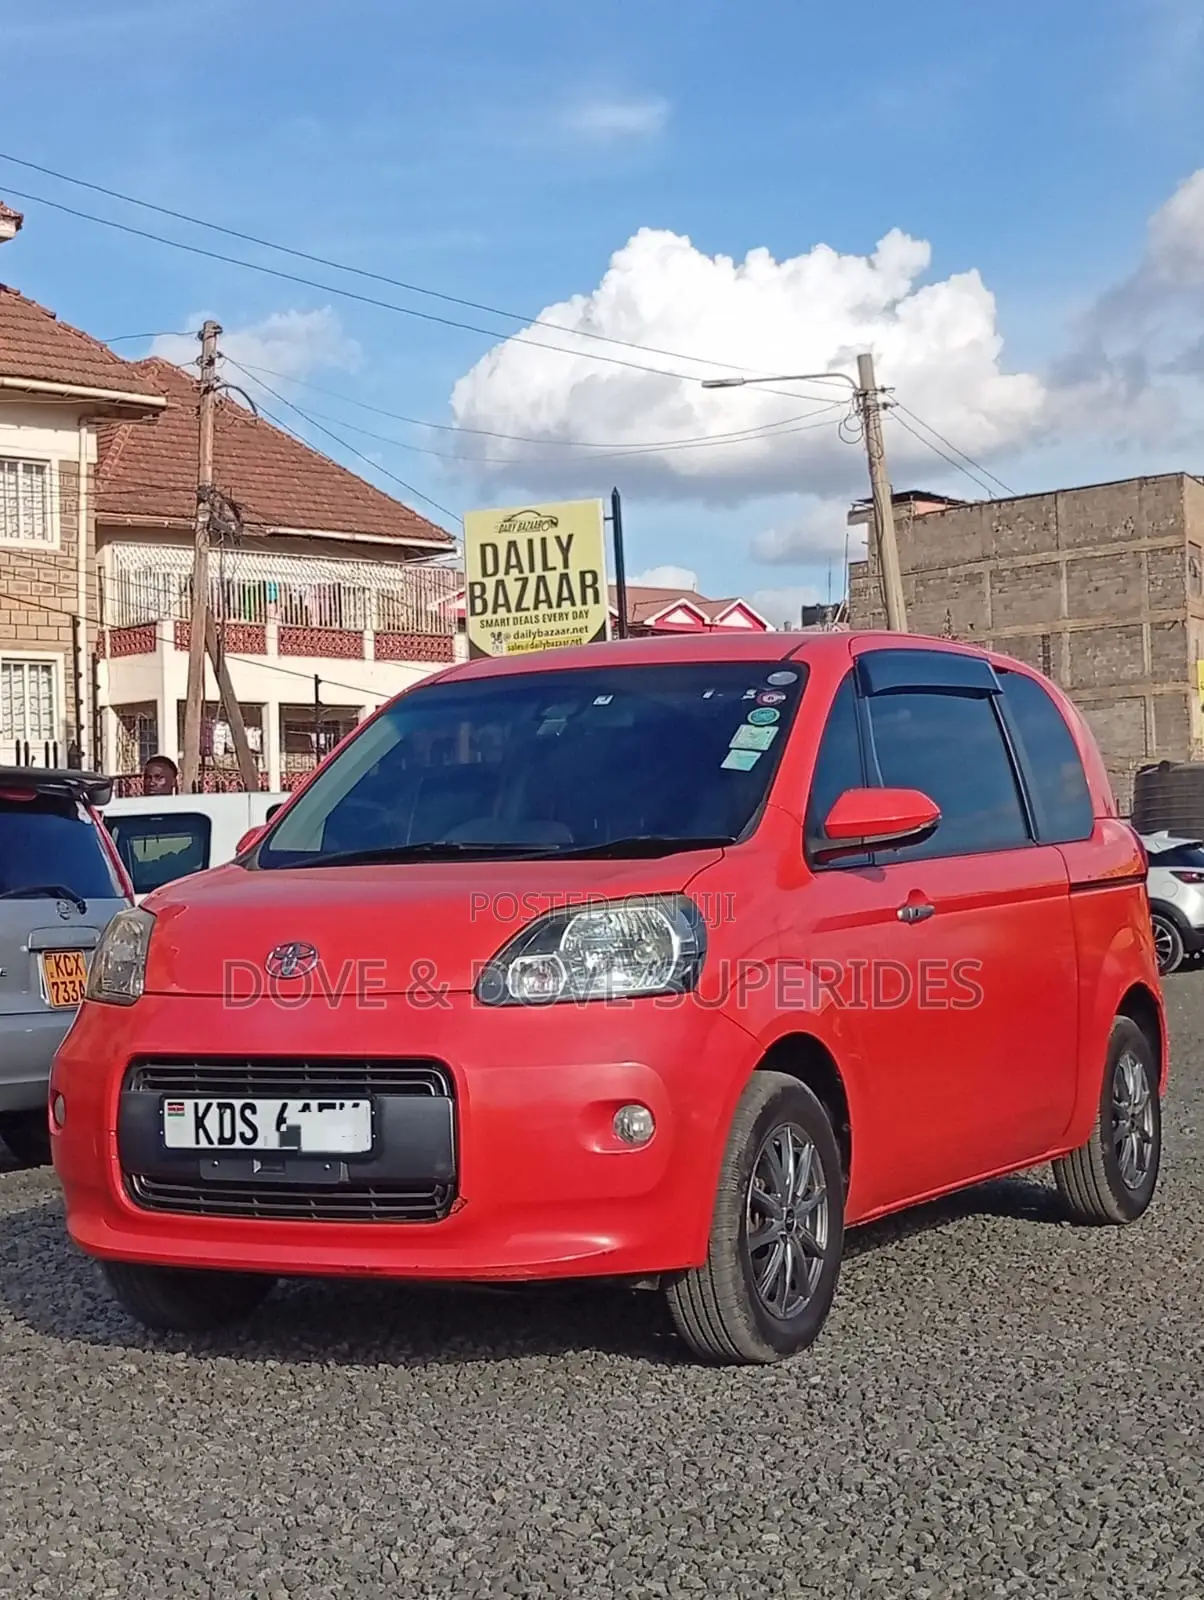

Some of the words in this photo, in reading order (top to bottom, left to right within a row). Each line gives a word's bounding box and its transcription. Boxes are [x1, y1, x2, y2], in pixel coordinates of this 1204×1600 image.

[480, 533, 574, 578] DAILY
[468, 569, 600, 617] BAZAAR
[479, 617, 510, 629] SMART
[512, 614, 540, 626] DEALS
[542, 611, 570, 623] EVERY
[571, 609, 590, 620] DAY
[53, 954, 83, 978] KCX
[194, 1102, 259, 1147] KDS
